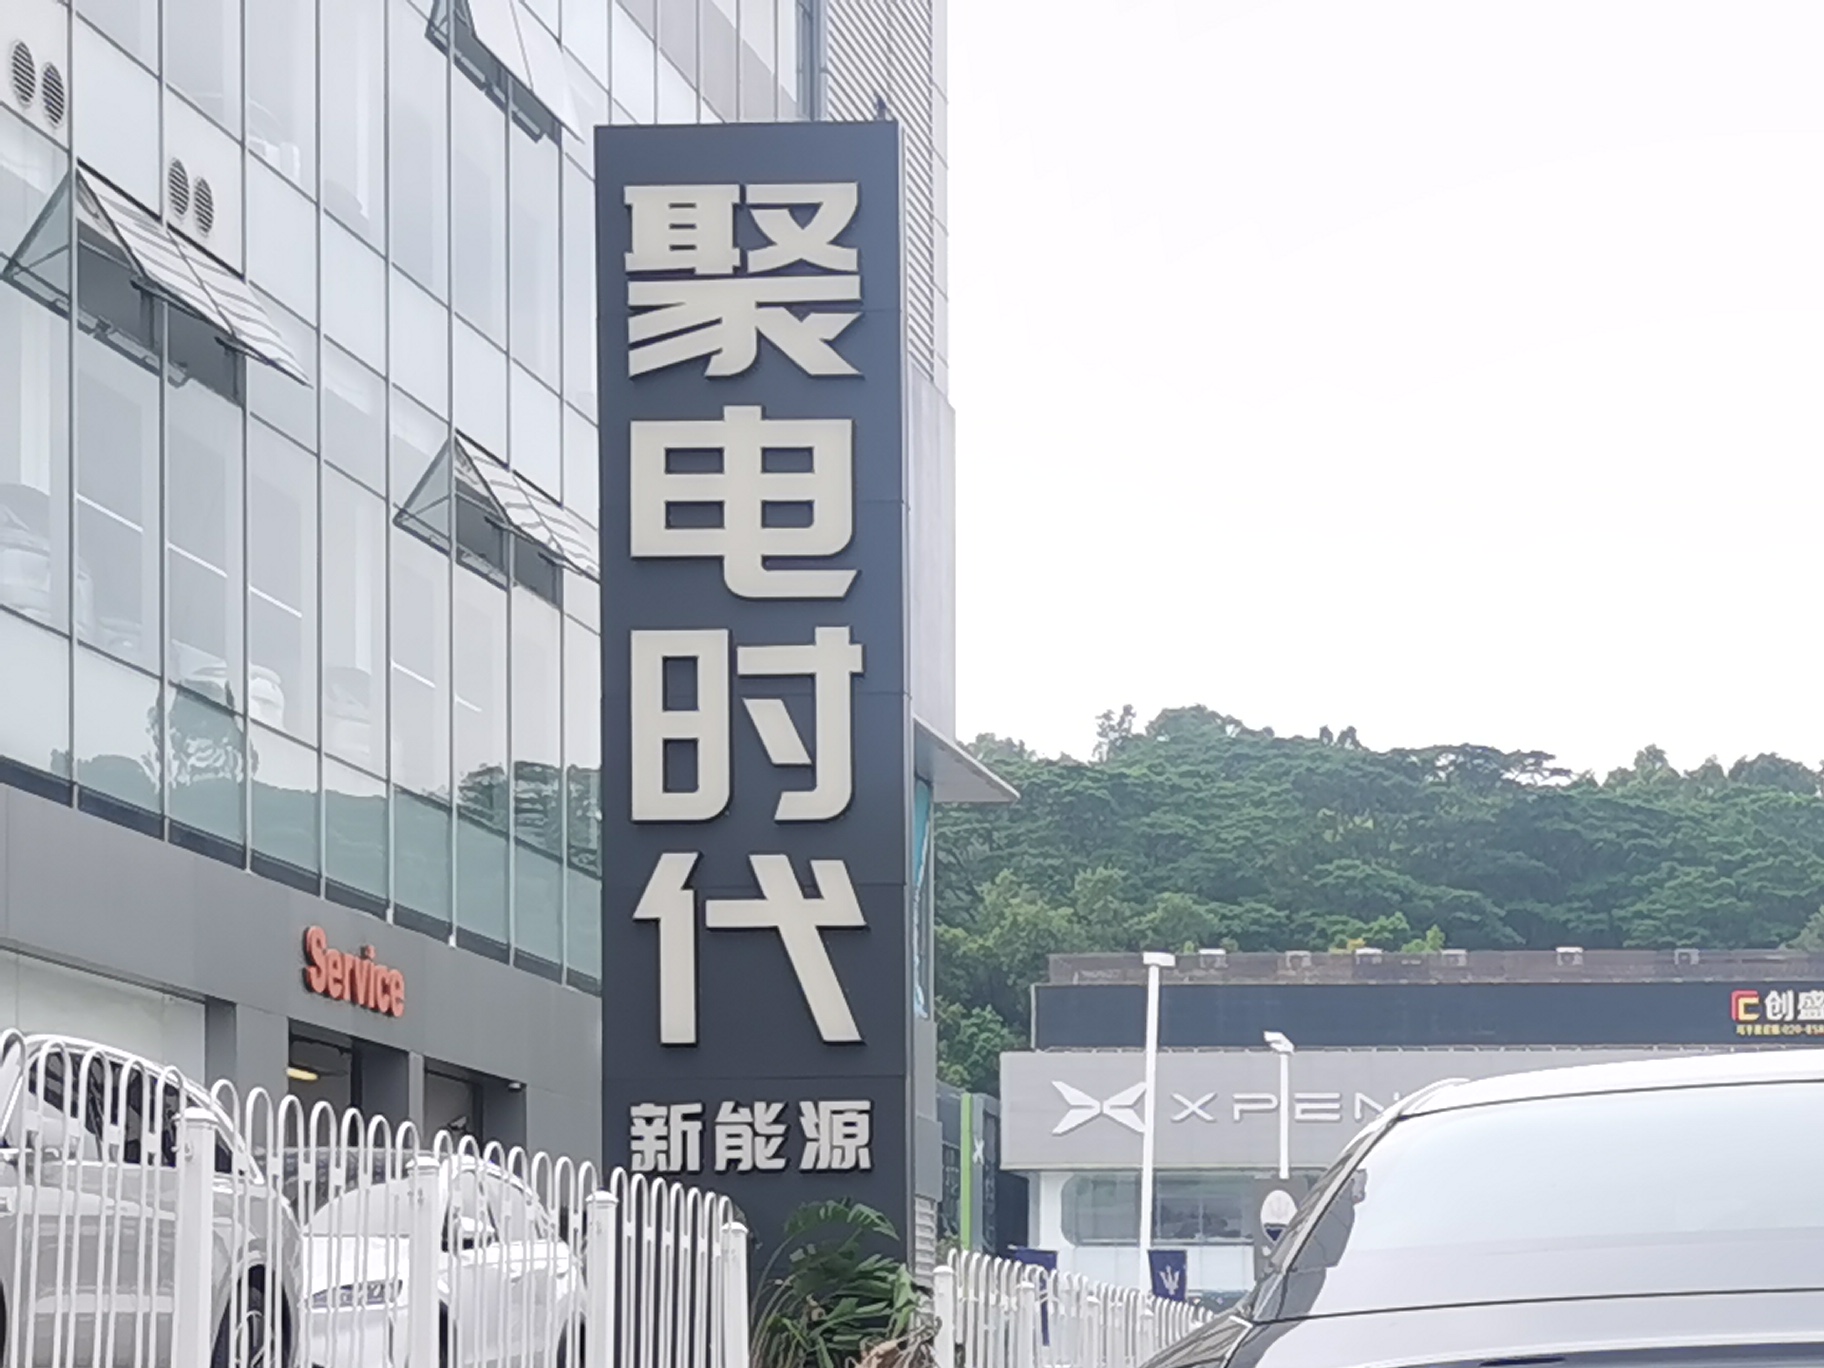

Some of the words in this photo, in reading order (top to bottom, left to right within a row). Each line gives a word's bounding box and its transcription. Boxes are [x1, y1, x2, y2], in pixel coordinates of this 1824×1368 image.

[623, 181, 867, 1046] 聚电时代
[303, 924, 405, 1018] Service
[628, 1098, 873, 1173] 新能源
